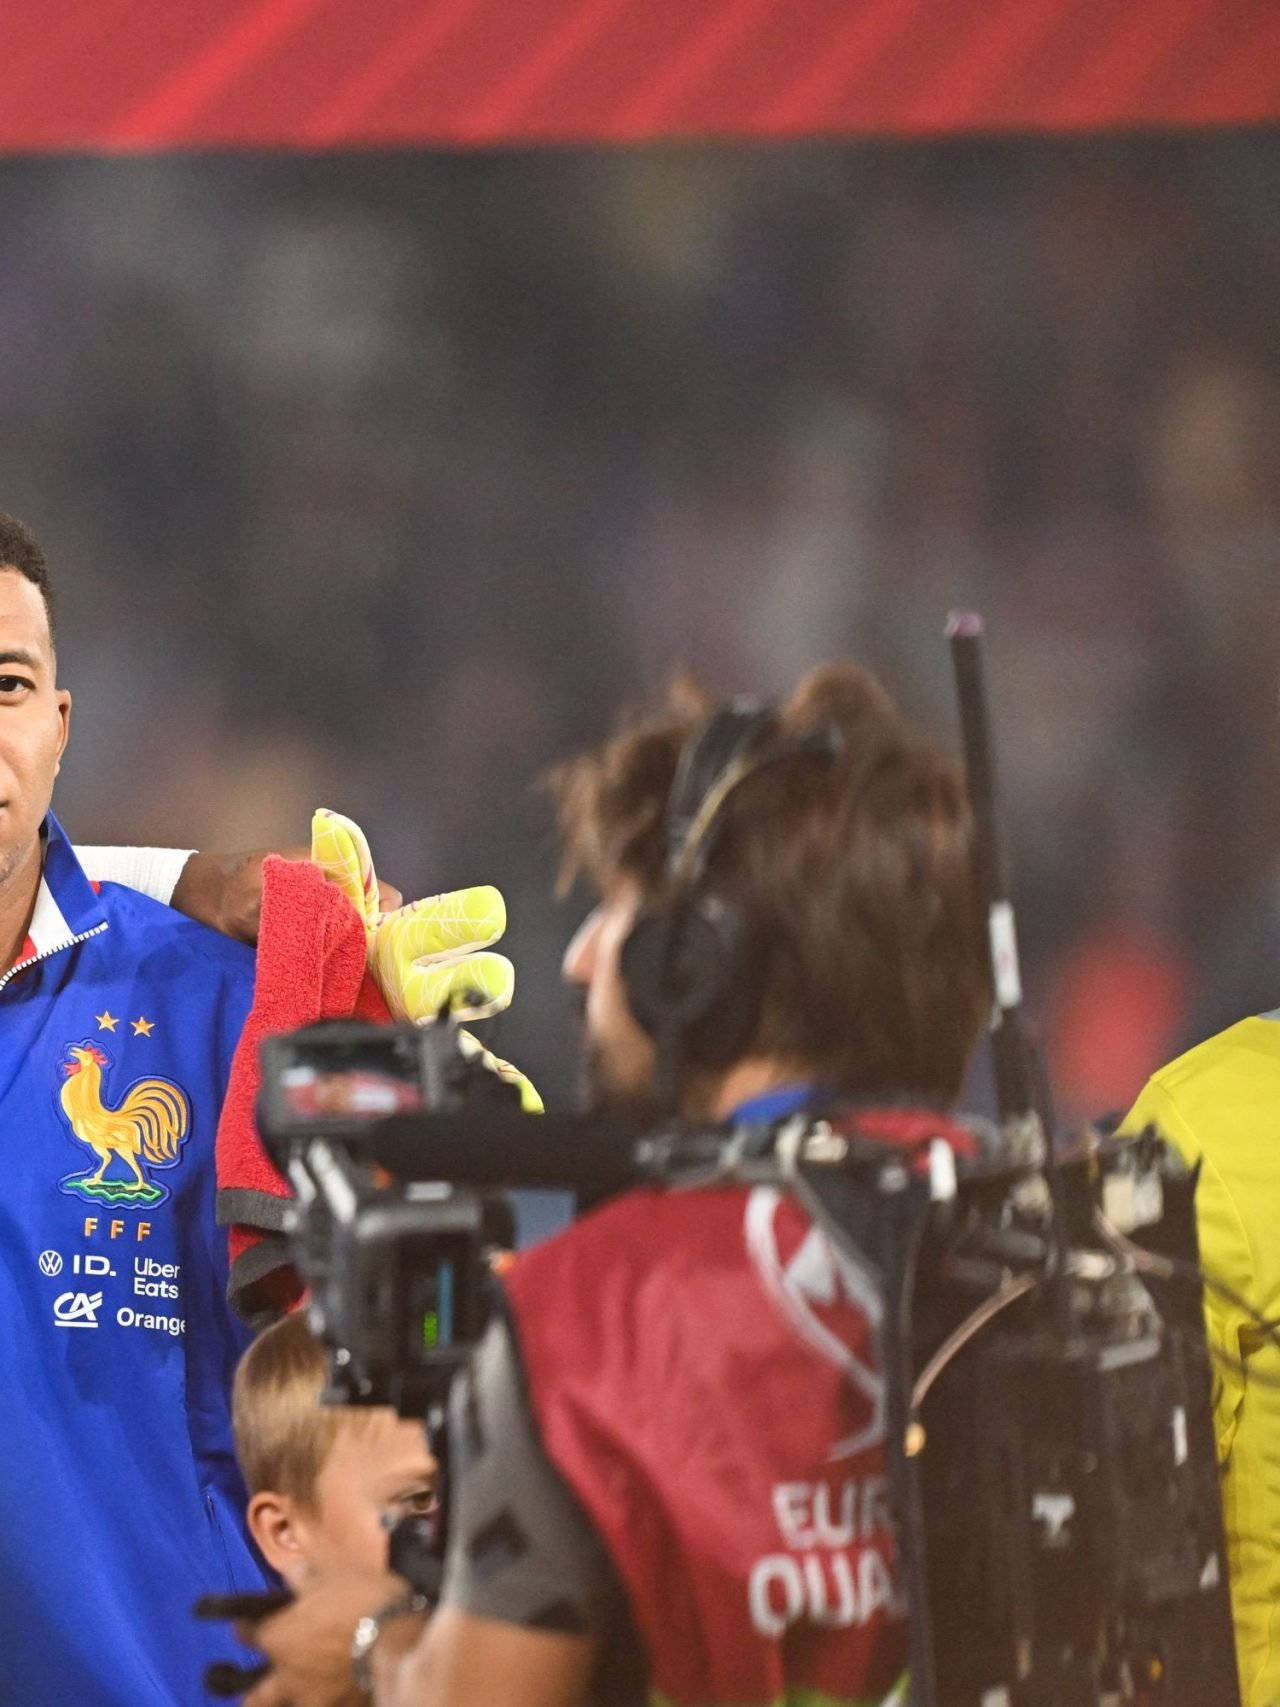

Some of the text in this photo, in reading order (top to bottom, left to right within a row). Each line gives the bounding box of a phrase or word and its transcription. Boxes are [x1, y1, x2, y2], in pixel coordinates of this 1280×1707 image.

[73, 1254, 116, 1276] ID.
[134, 1256, 180, 1278] Uber
[133, 1277, 179, 1299] Eats
